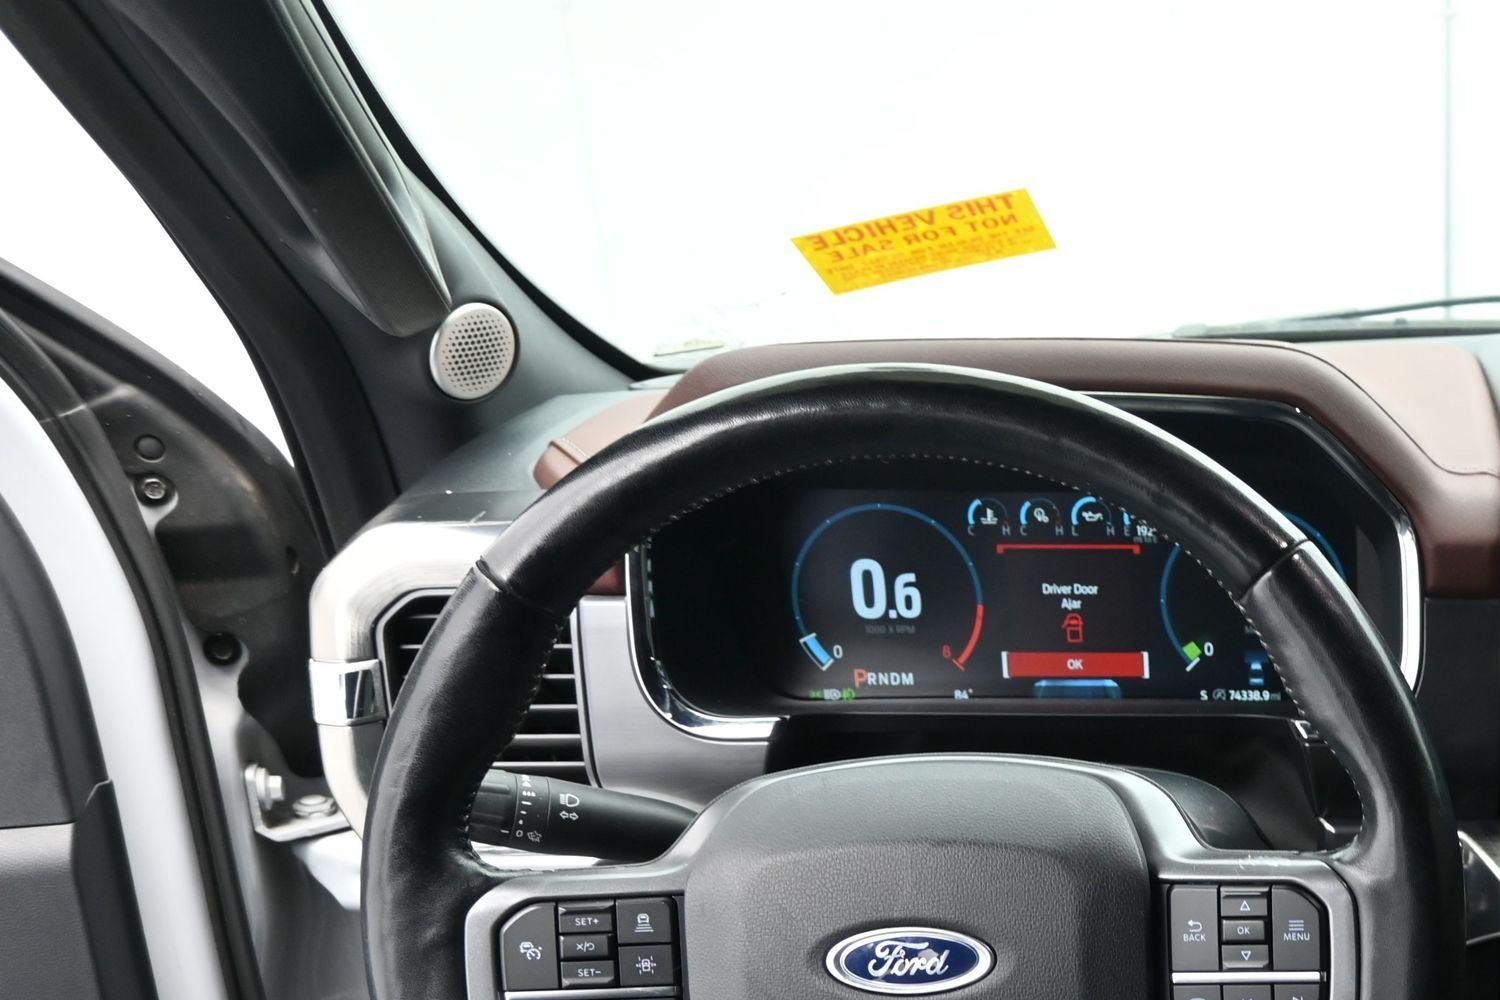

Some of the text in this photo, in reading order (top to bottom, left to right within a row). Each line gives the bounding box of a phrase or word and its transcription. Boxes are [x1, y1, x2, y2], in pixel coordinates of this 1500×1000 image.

[850, 558, 922, 620] 0.6
[1042, 583, 1098, 596] Driver Door
[1061, 598, 1081, 610] Ajar
[832, 645, 843, 659] 0
[1203, 642, 1214, 656] 0
[1067, 659, 1083, 670] OK
[1237, 926, 1250, 935] OK
[1283, 932, 1311, 941] MENU
[1183, 933, 1206, 942] BACK
[867, 940, 951, 977] Ford
